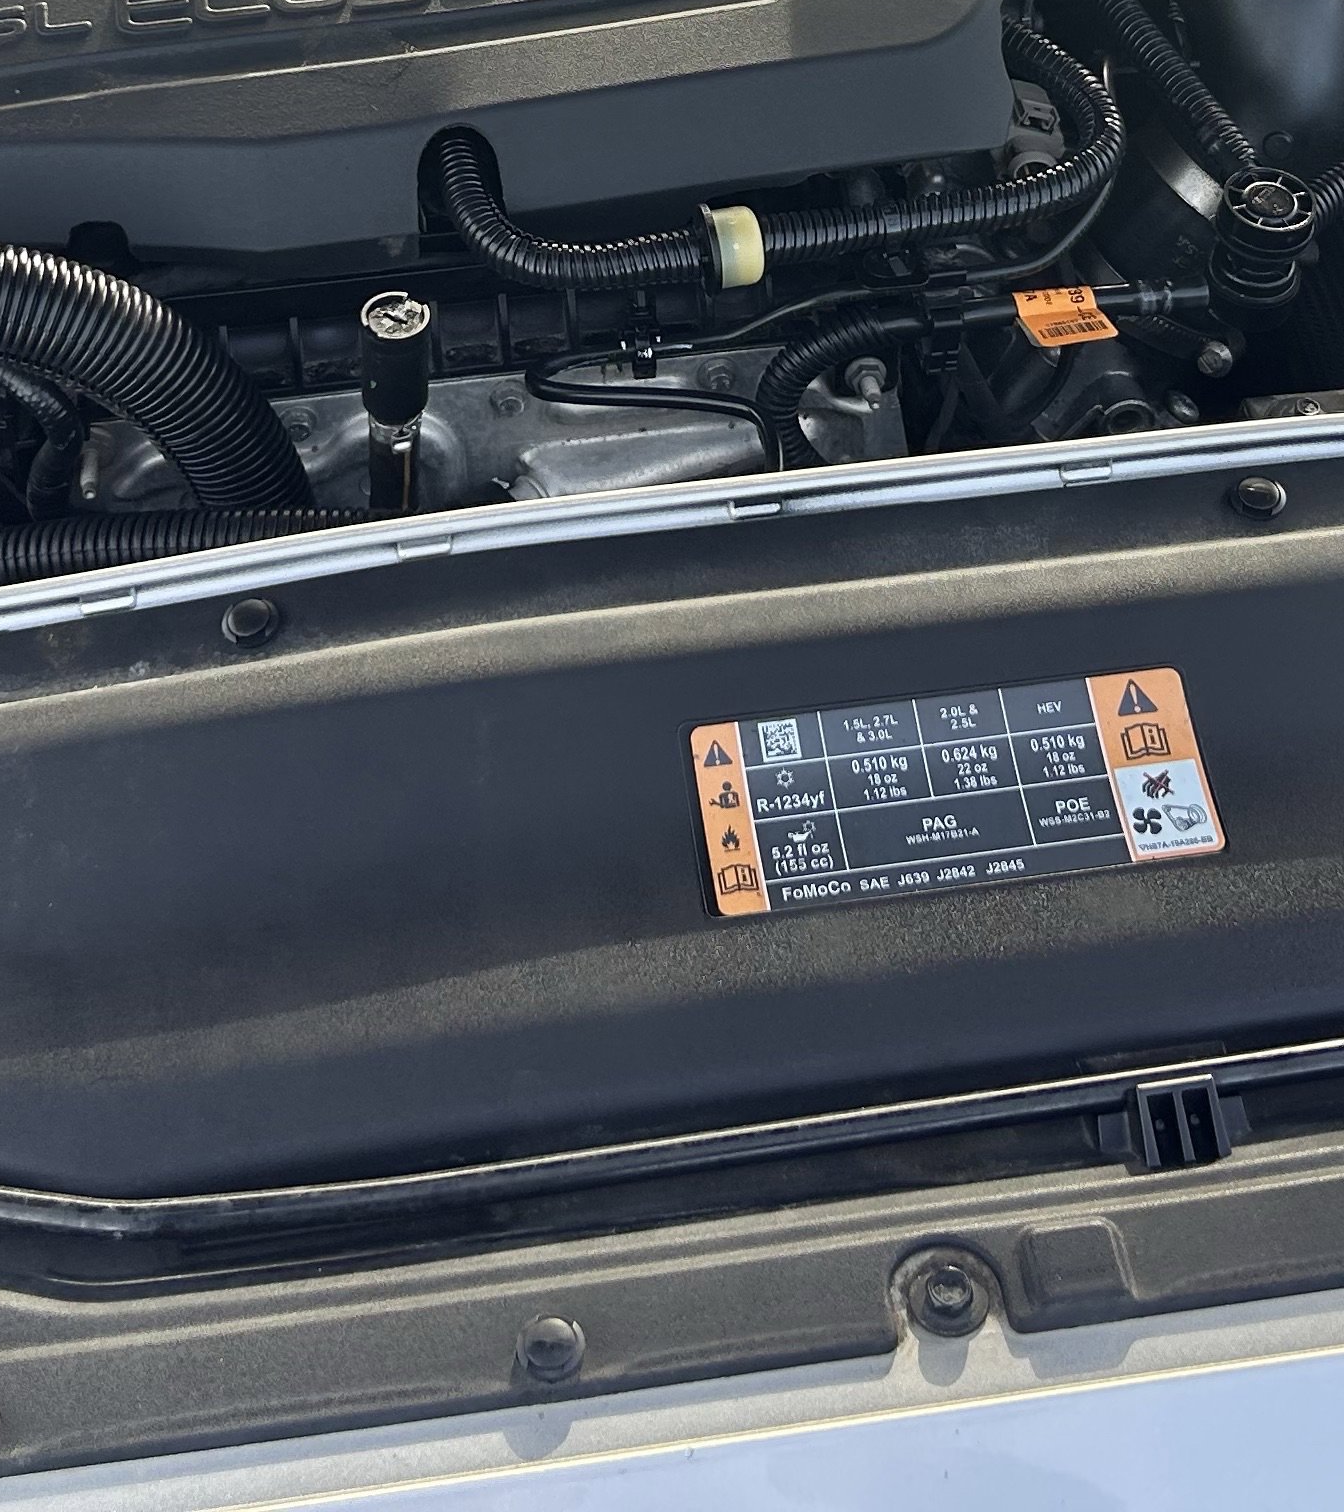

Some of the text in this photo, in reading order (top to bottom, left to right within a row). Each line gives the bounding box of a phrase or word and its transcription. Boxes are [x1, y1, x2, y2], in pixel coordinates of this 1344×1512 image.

[938, 702, 979, 719] 2.0L &
[1035, 699, 1062, 714] HEV
[842, 713, 898, 733] 1.5L, 2.7L
[949, 715, 977, 730] 2.5L
[855, 727, 893, 744] & 3.0L
[1029, 731, 1085, 752] 0.510 kg
[940, 741, 998, 763] 0.624 kg
[1045, 750, 1076, 764] 18 oz
[850, 752, 908, 774] 0.510 kg
[956, 762, 988, 776] 22 oz
[1042, 761, 1086, 778] 1.12 lbs
[867, 772, 898, 786] 18 oz
[953, 772, 998, 790] 1.38 lbs
[862, 784, 907, 801] 1.12 lbs
[755, 789, 826, 816] R-1234yf
[1054, 795, 1091, 814] POE
[920, 812, 958, 831] PAG
[770, 841, 830, 860] 5.2 fl oz
[774, 853, 834, 877] (155 cc)
[780, 857, 1026, 902] FoMoCo SAE J639 J2842 J2845
